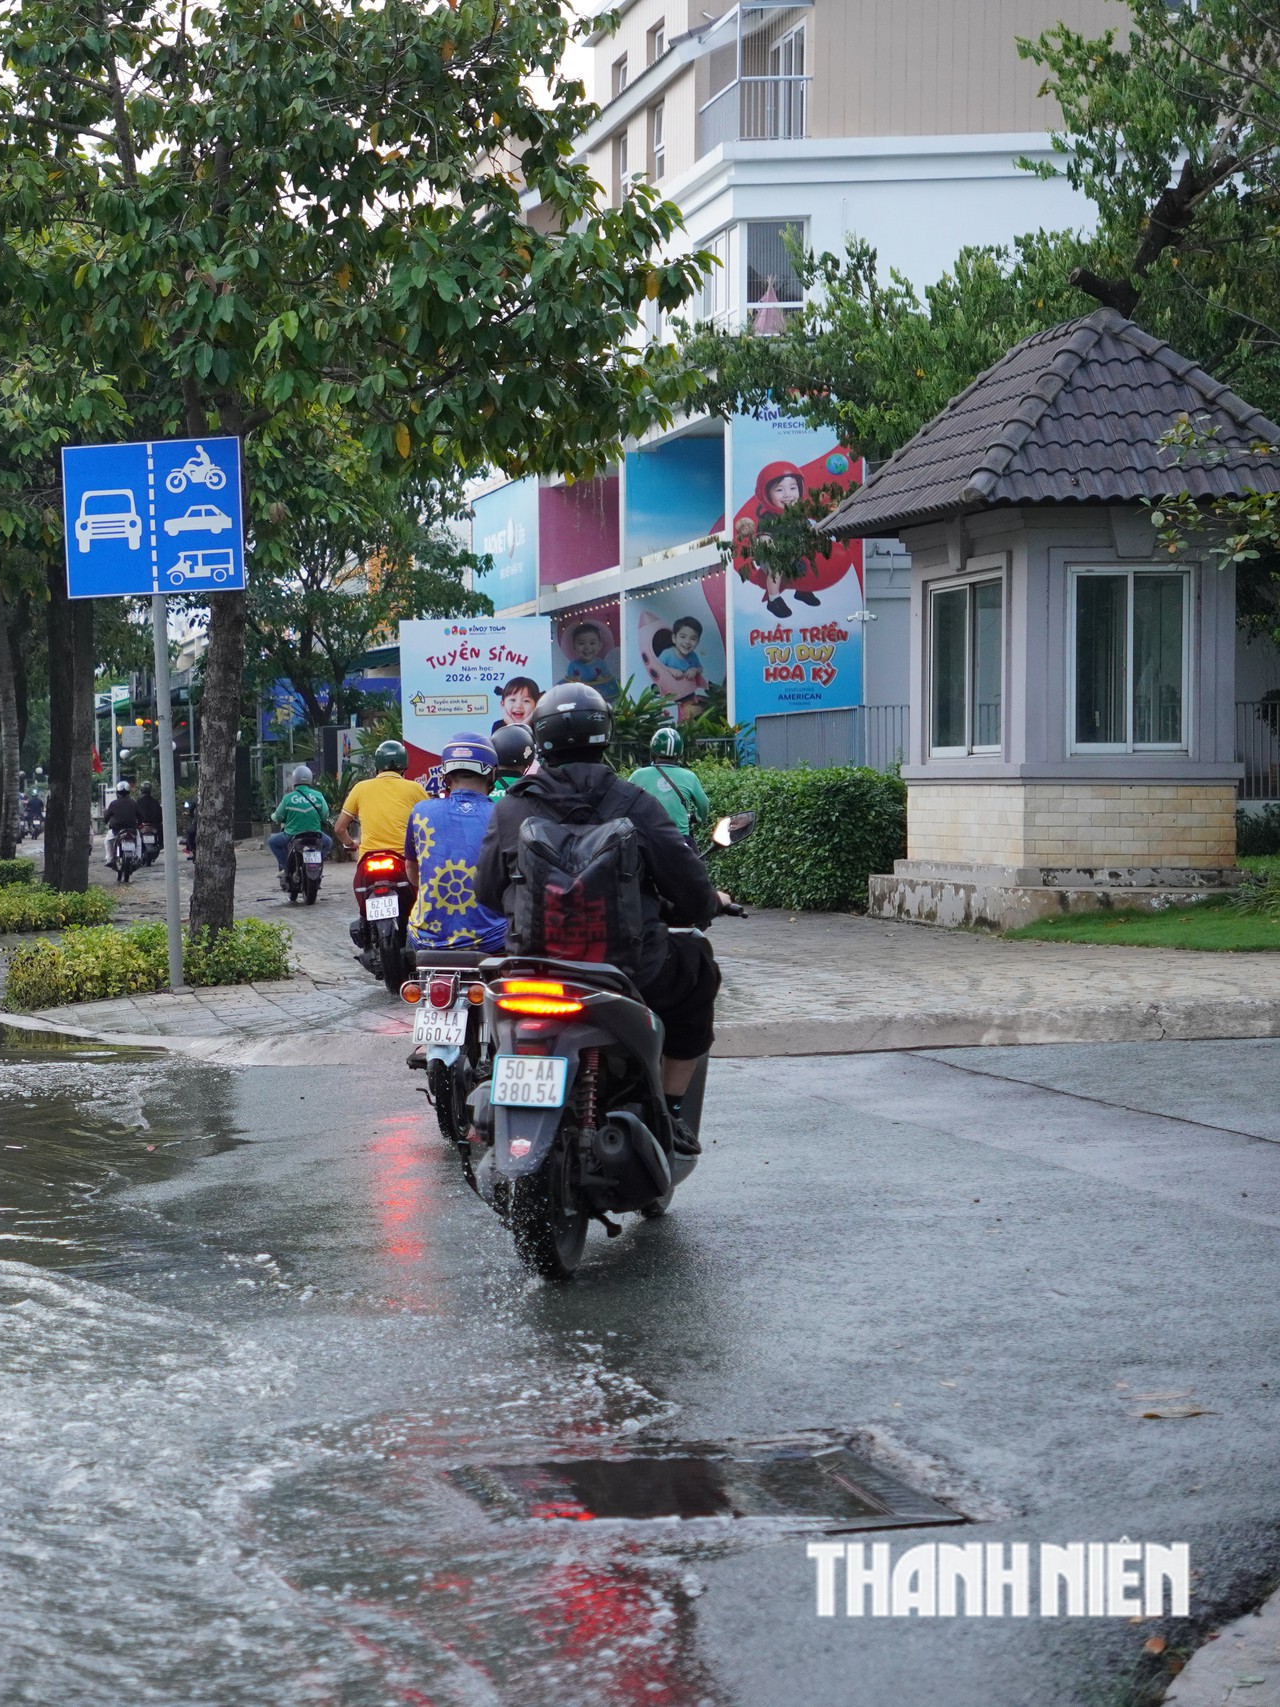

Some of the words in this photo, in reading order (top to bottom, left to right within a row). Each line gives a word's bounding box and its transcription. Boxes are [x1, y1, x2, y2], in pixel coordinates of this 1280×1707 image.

[772, 421, 806, 429] PRESCH
[750, 623, 793, 646] PHÁT
[800, 621, 848, 643] TRIỂN
[426, 641, 480, 669] TUYỂN
[796, 644, 834, 663] DUY
[445, 674, 471, 682] 2026
[480, 673, 505, 681] 2027
[765, 664, 805, 682] HOA
[812, 662, 837, 687] KỲ
[426, 705, 436, 713] 12
[467, 704, 473, 712] 5
[291, 794, 316, 805] Grab
[371, 899, 393, 909] 62-LD
[369, 908, 397, 919] 404.58
[423, 1011, 458, 1027] 59-LA
[417, 1027, 462, 1042] 060.47
[506, 1060, 554, 1081] 50-AA
[498, 1082, 557, 1104] 380.54
